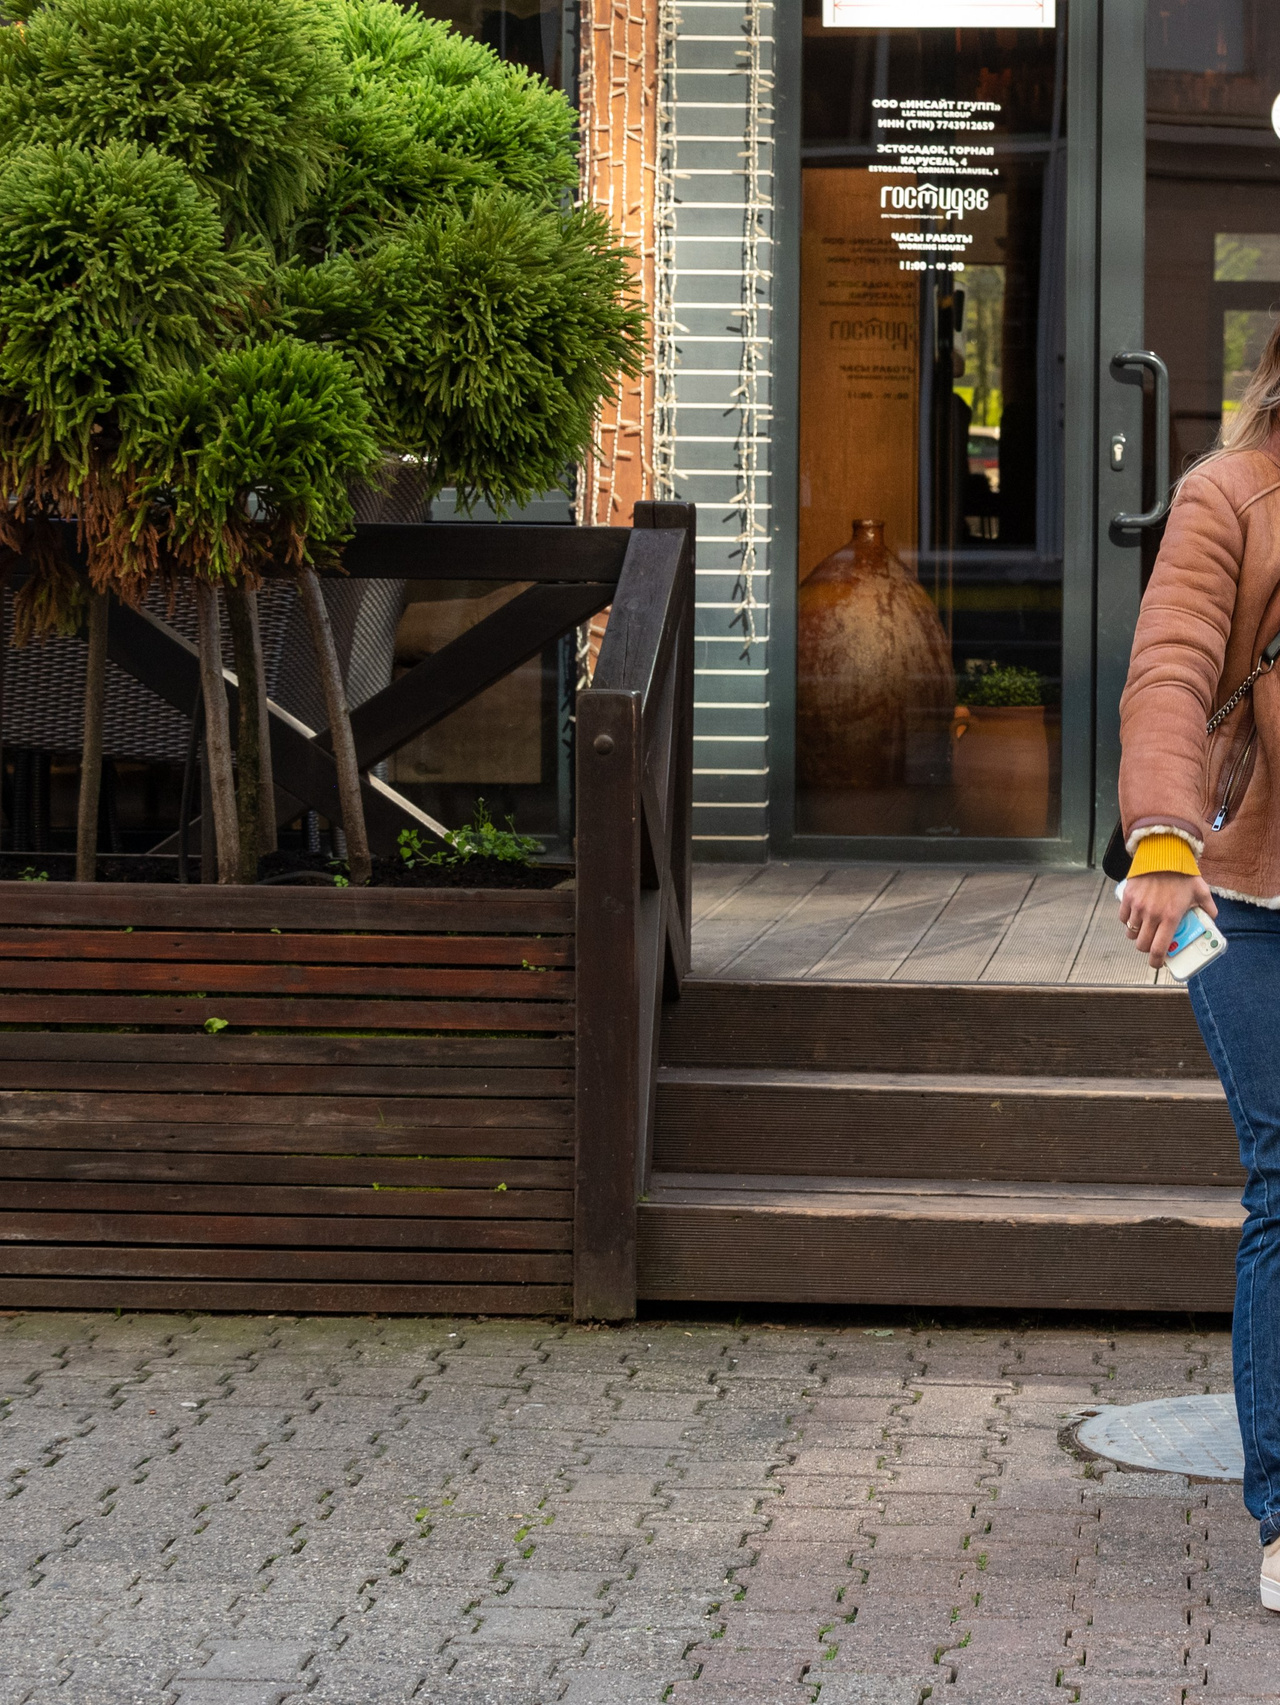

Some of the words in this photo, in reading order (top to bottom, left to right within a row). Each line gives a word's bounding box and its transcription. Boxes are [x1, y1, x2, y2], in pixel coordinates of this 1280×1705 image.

[872, 99, 898, 109] ООО
[900, 99, 955, 110] «ИНСАЙТ
[957, 102, 1001, 112] ГРУПП»
[878, 119, 905, 128] ИНН
[906, 120, 935, 131] (TIN)
[936, 121, 995, 130] 7743912659
[877, 144, 948, 155] ЭСТОСАДОК,
[950, 146, 994, 155] ГОРНАЯ
[901, 156, 959, 167] КАРУСЕЛЬ,
[961, 158, 967, 166] 4
[891, 233, 924, 242] ЧАСЫ
[926, 234, 973, 243] РАБОТЫ
[898, 243, 937, 251] WORKING
[900, 261, 927, 271] 11:00
